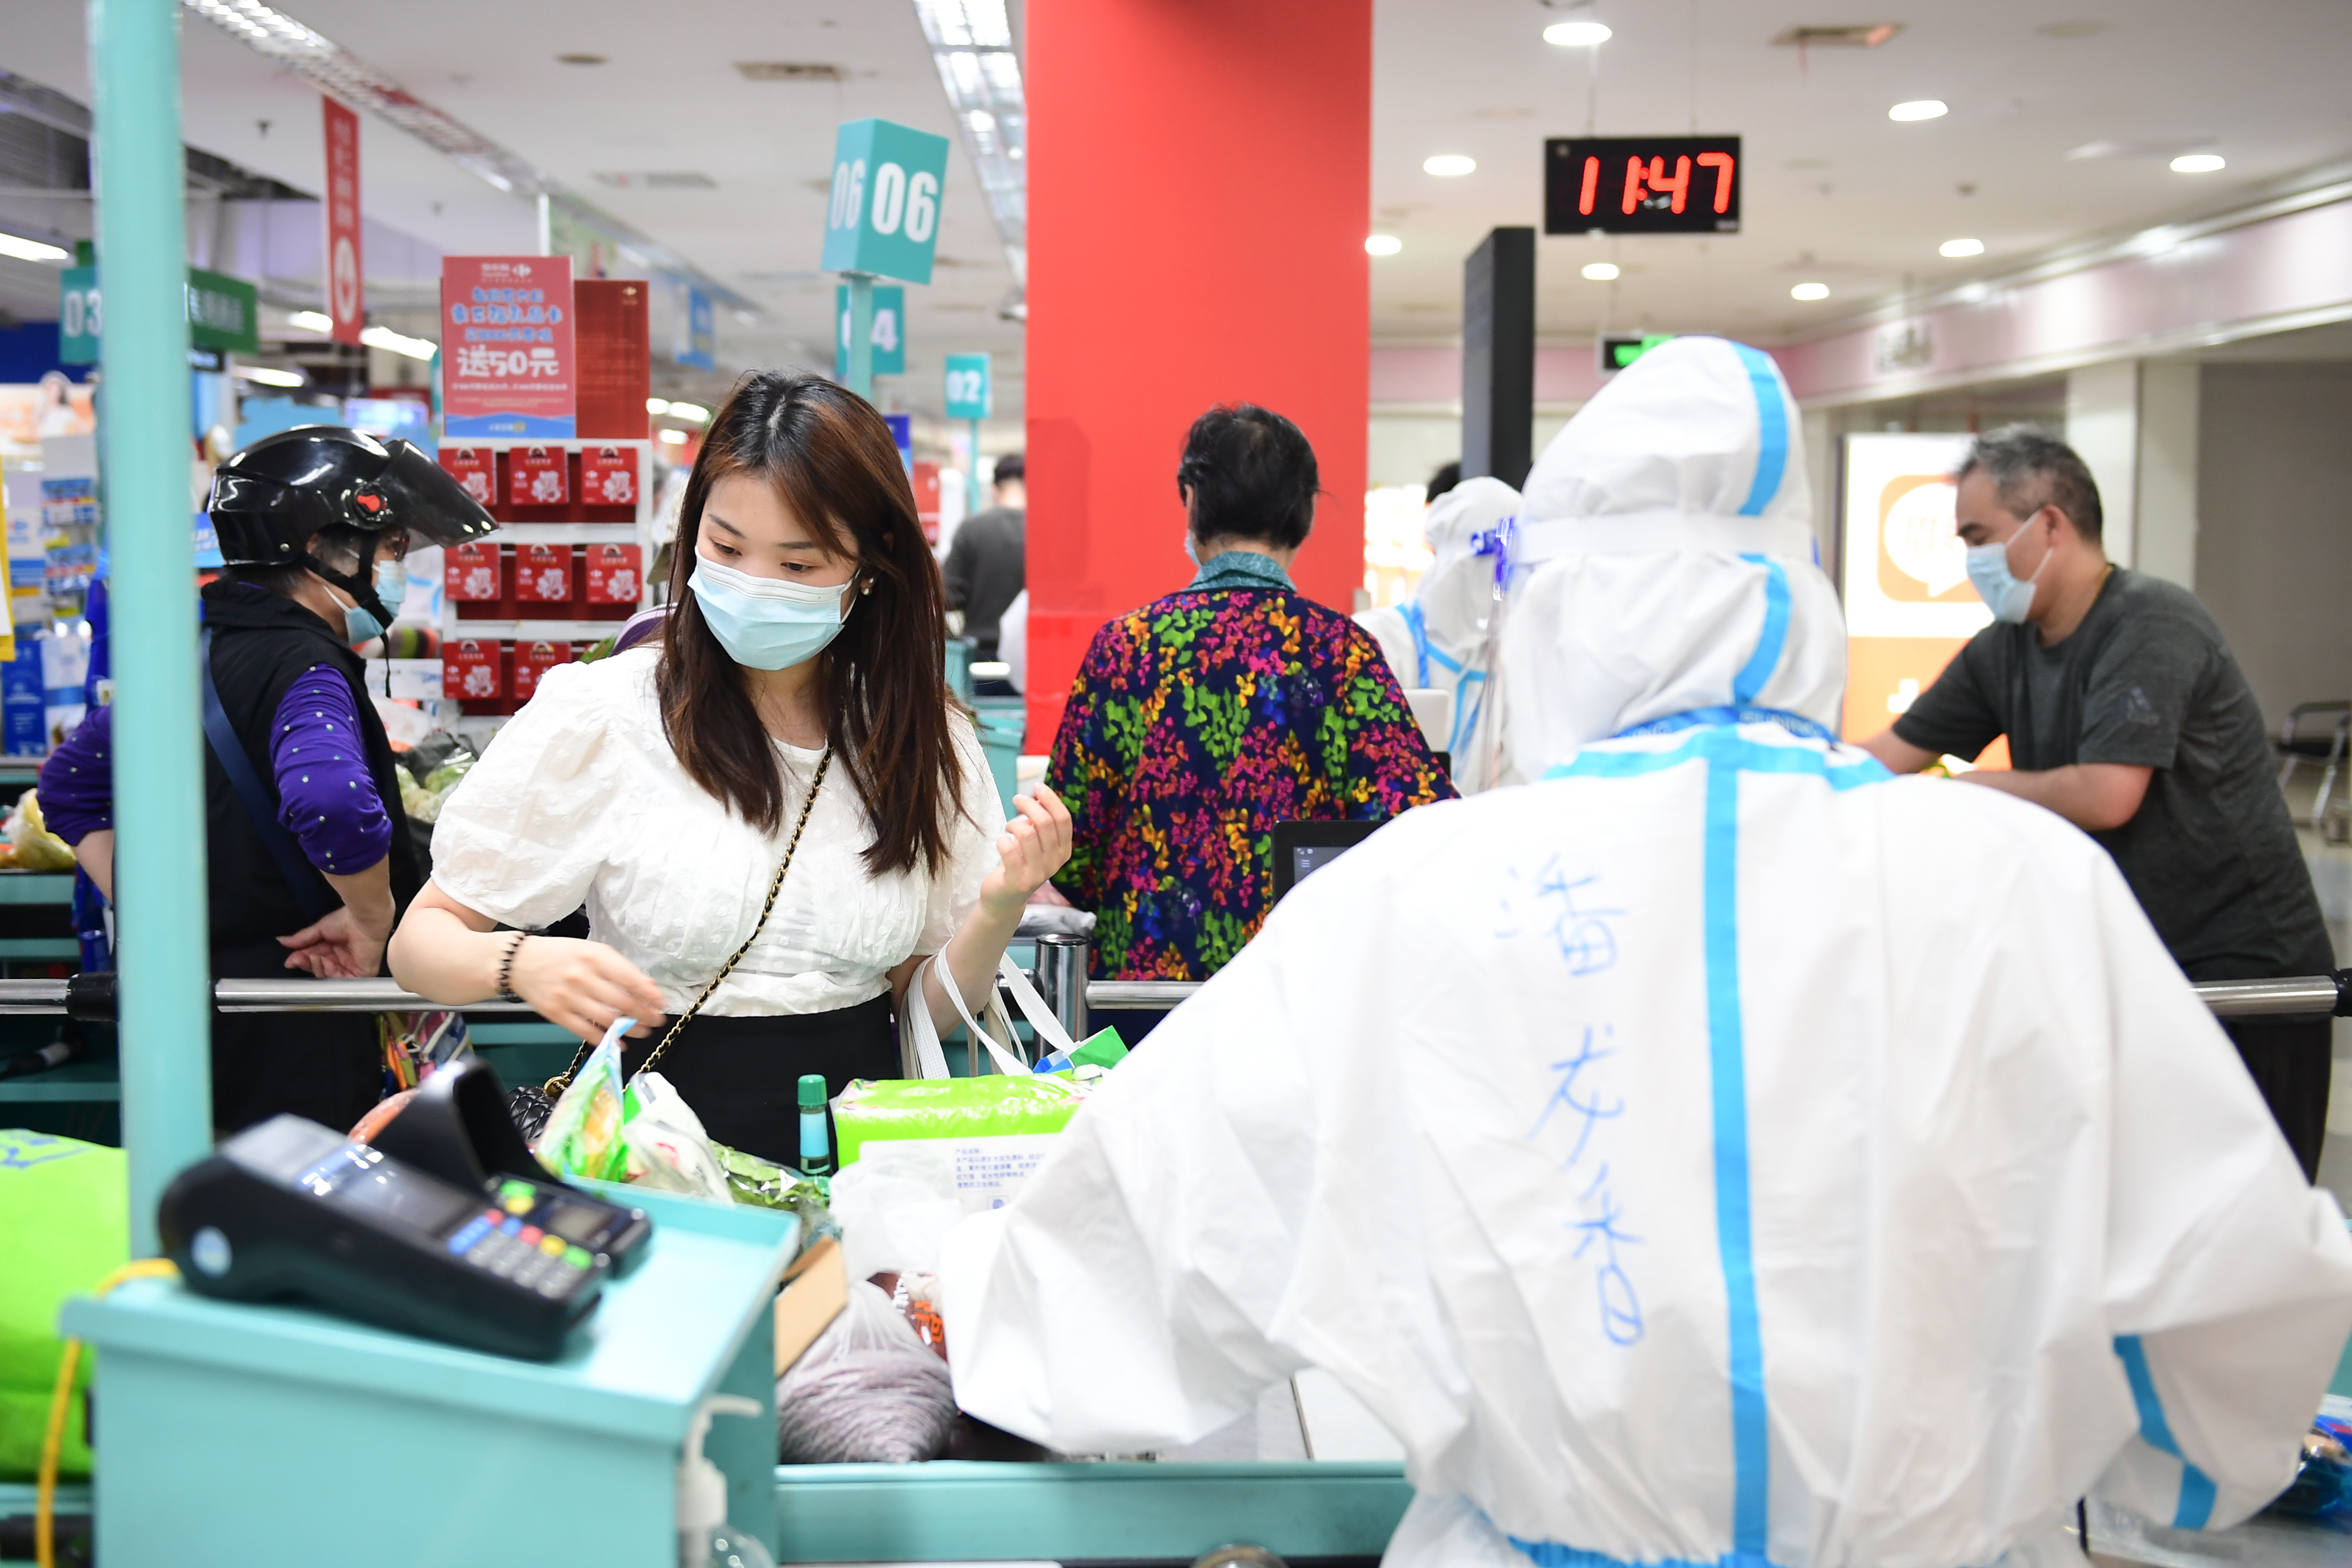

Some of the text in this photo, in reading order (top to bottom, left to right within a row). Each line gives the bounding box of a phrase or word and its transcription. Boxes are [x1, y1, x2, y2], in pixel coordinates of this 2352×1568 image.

[830, 159, 866, 230] 06
[870, 162, 938, 242] 06
[1579, 152, 1734, 215] 11:47
[64, 289, 103, 337] 03
[457, 343, 559, 378] 送50元
[946, 369, 982, 404] 02
